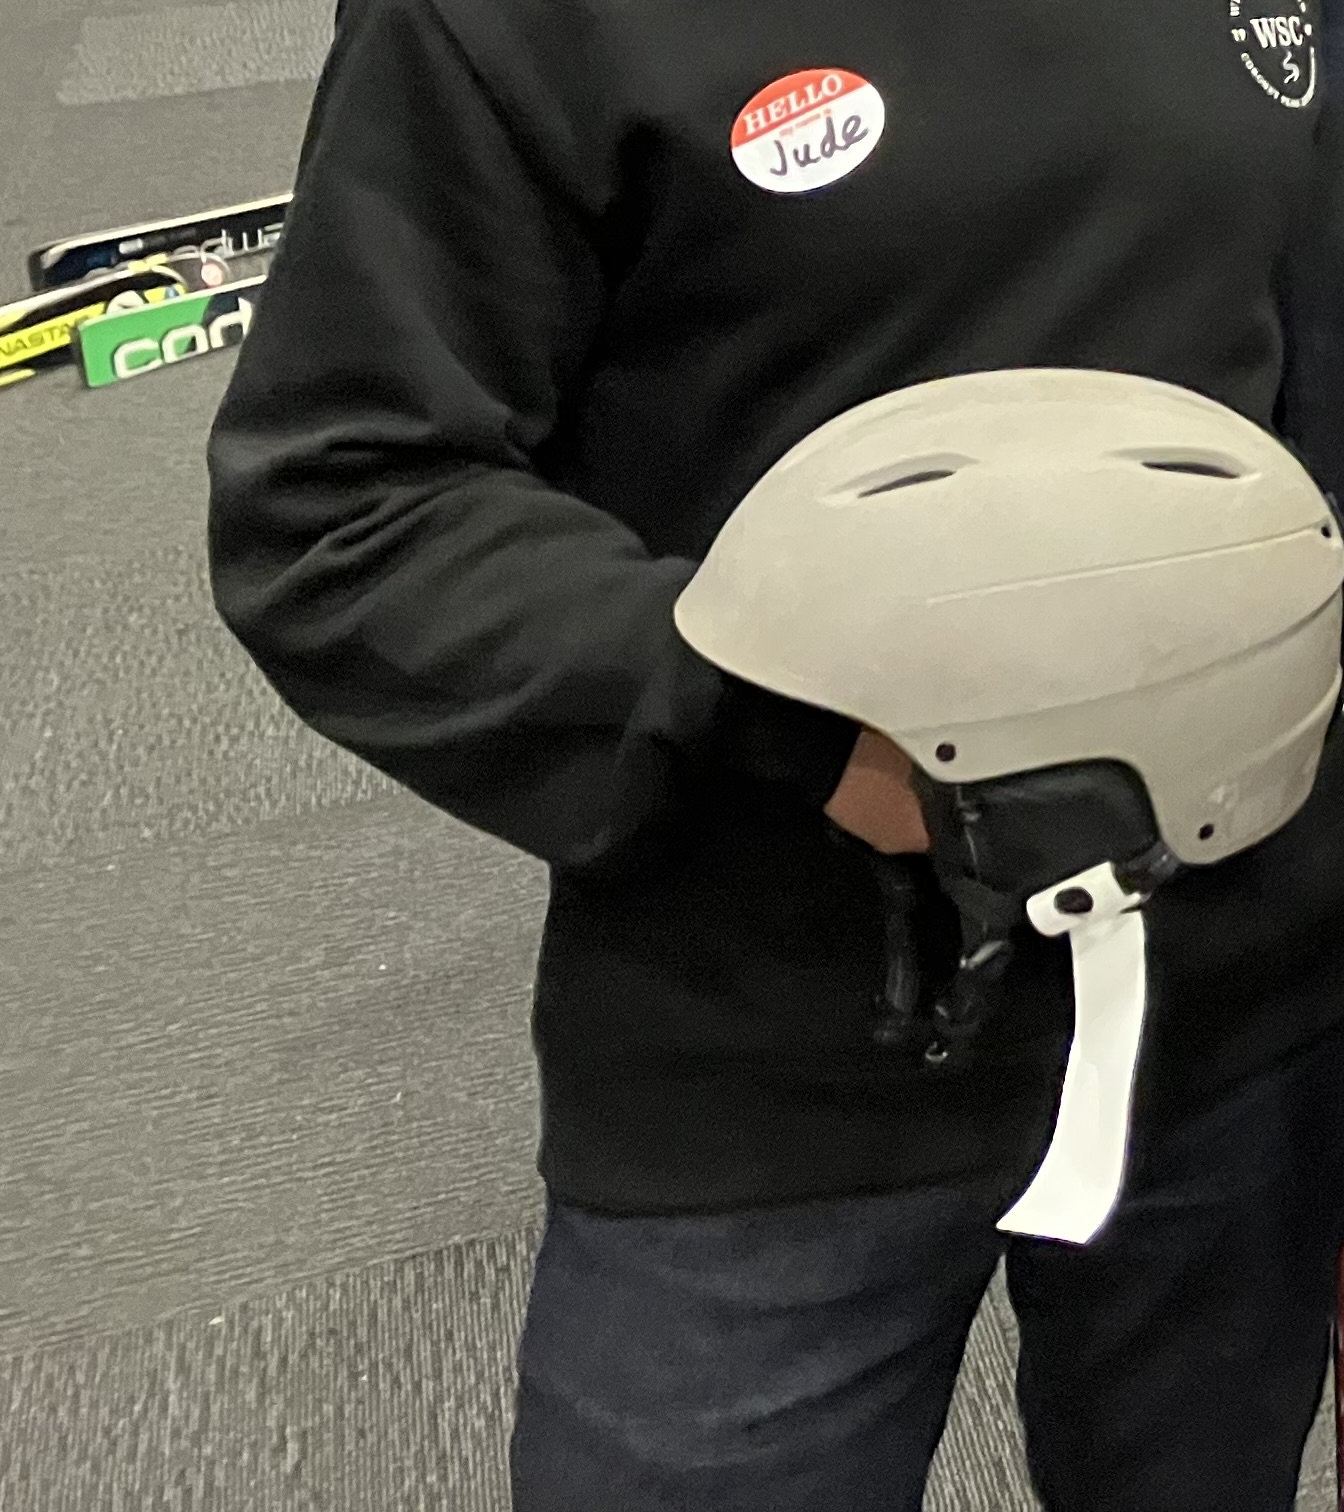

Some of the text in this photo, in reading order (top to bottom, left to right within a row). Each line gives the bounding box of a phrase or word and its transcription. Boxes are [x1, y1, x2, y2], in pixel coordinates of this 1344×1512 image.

[1250, 15, 1305, 50] WSC
[743, 74, 843, 136] HELLO
[769, 114, 869, 177] Jude
